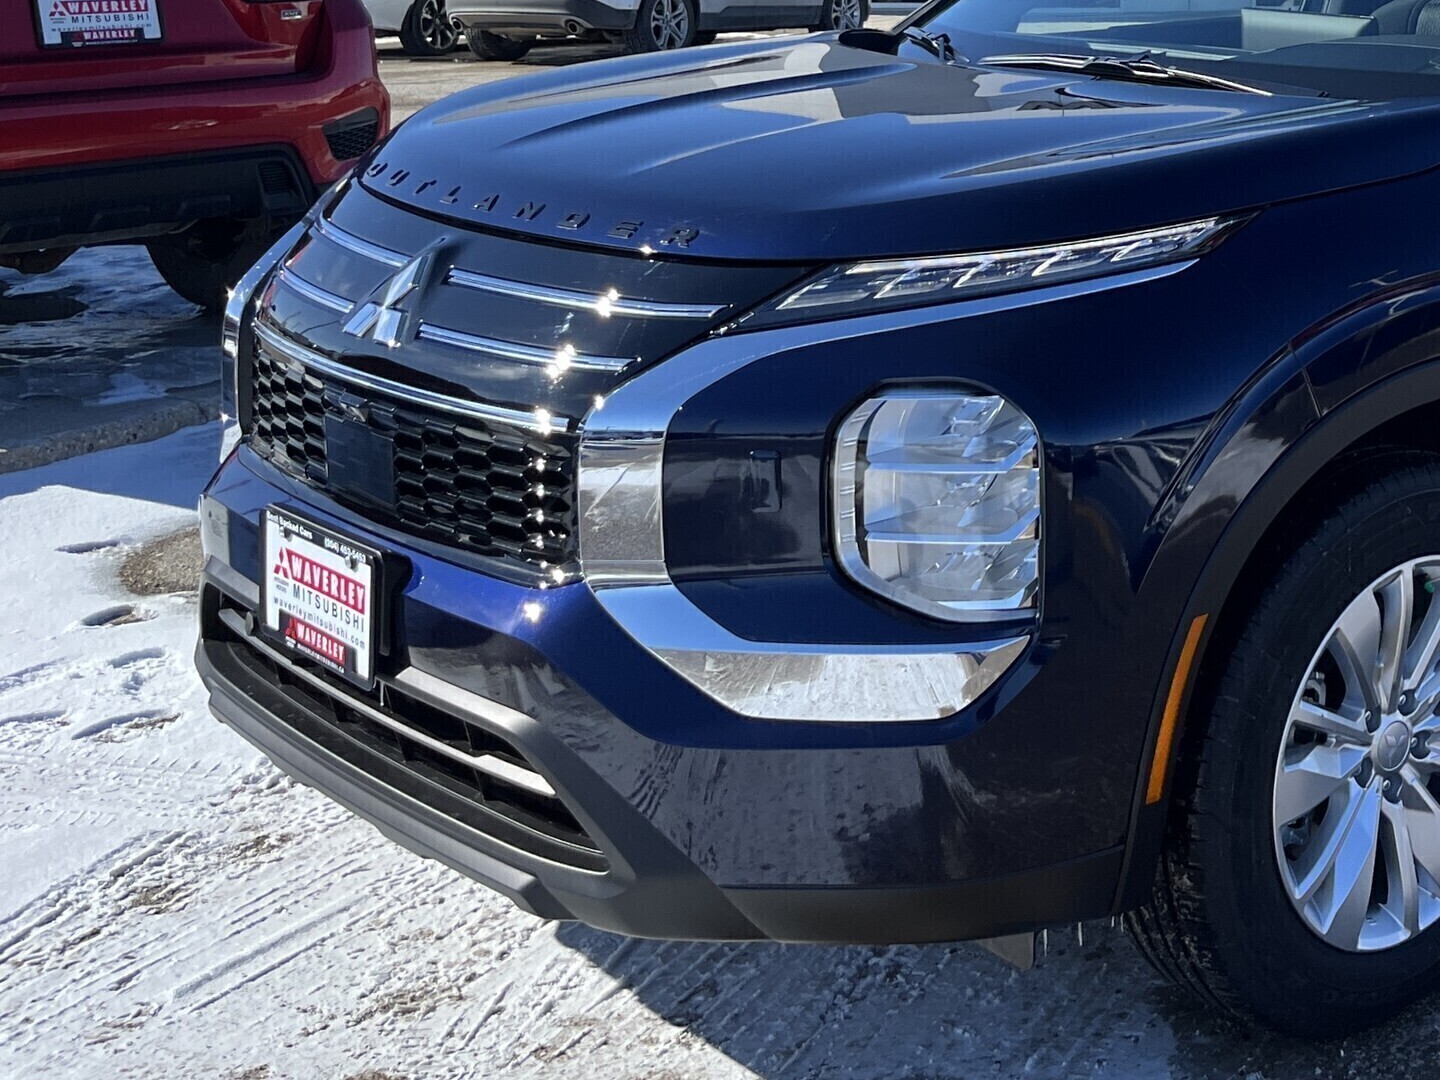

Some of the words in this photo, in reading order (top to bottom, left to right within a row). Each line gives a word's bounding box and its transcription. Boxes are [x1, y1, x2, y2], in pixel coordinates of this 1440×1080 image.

[67, 0, 146, 14] WAVERLEY
[71, 13, 150, 23] MITSUBISHI
[83, 29, 136, 40] WAVERLEY
[299, 525, 313, 539] Cars
[291, 554, 365, 610] WAVERLEY
[293, 583, 364, 632] MITSUBISHI
[273, 596, 365, 649] waverleymitsubishi.com
[296, 622, 345, 661] WAVERLEY
